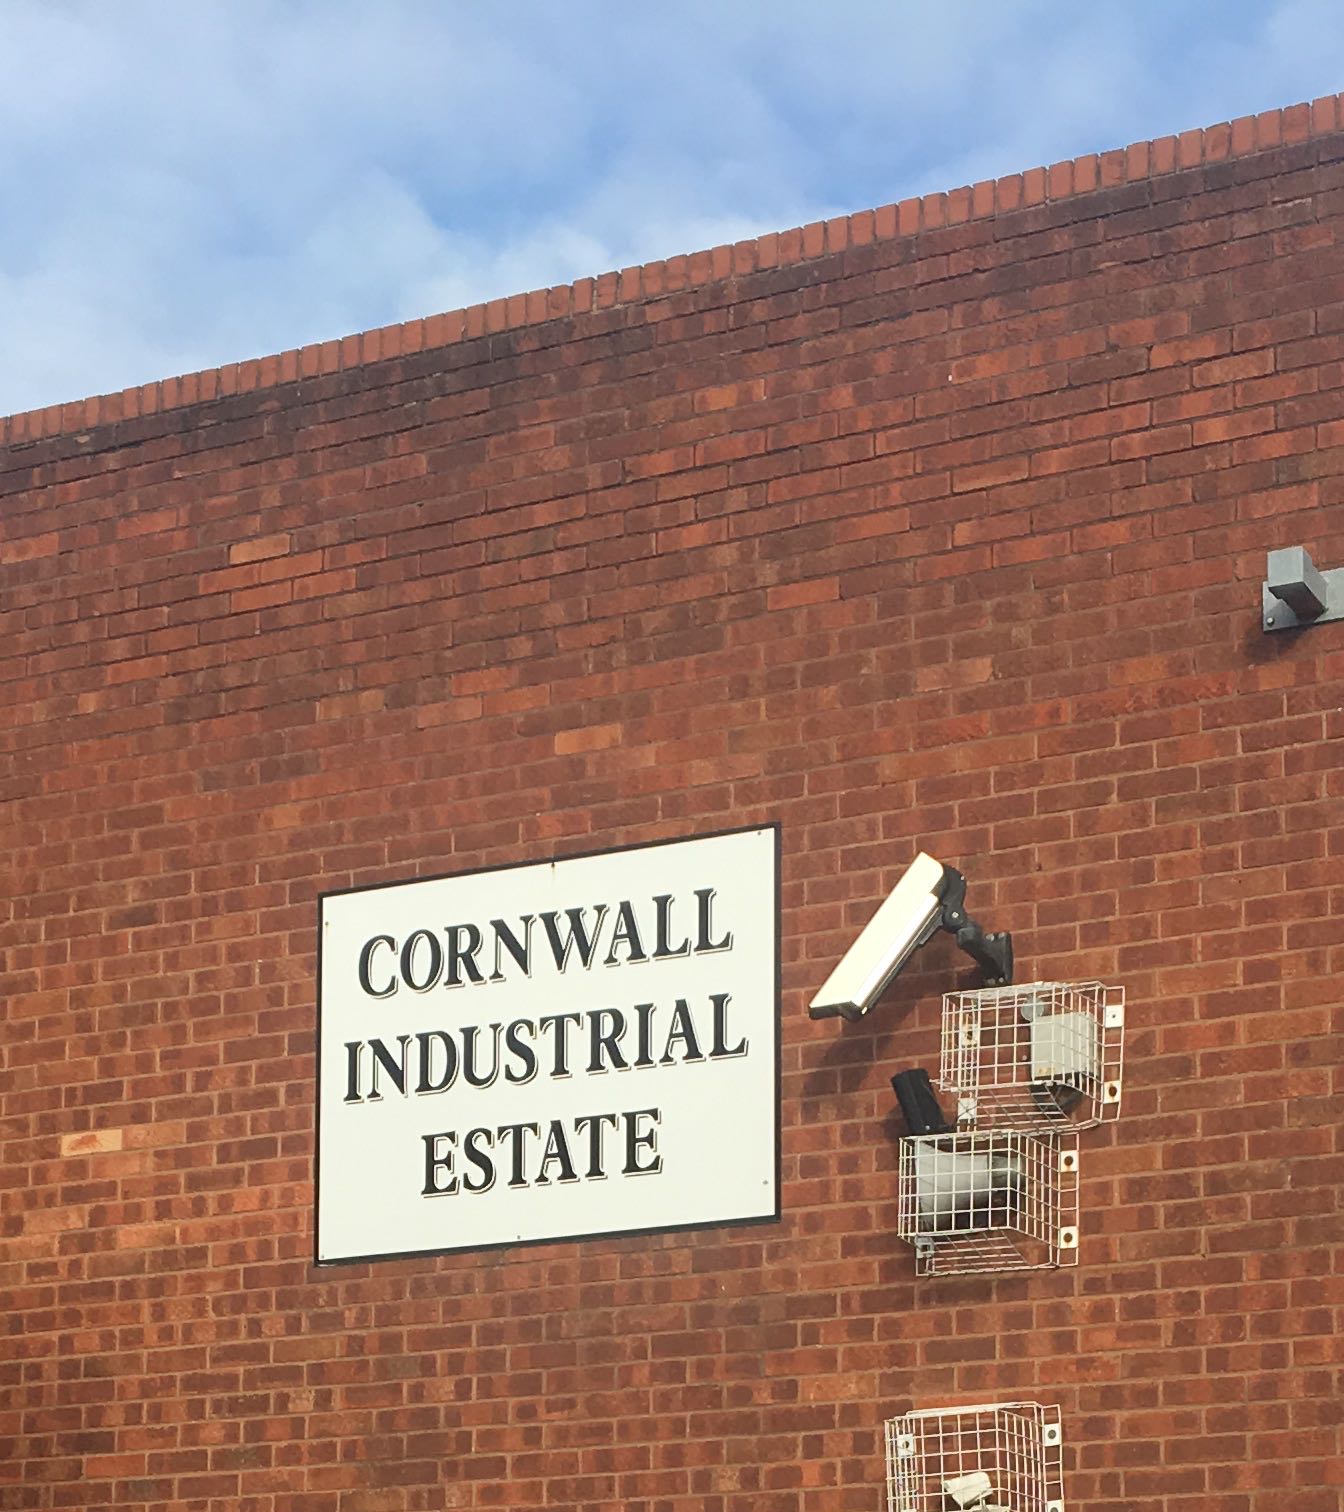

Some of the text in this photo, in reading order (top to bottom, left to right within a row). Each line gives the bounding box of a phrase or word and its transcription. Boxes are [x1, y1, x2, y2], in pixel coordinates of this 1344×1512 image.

[358, 887, 734, 999] CORNWALL
[343, 992, 749, 1105] INDUSTRIAL
[421, 1107, 663, 1198] ESTATE
